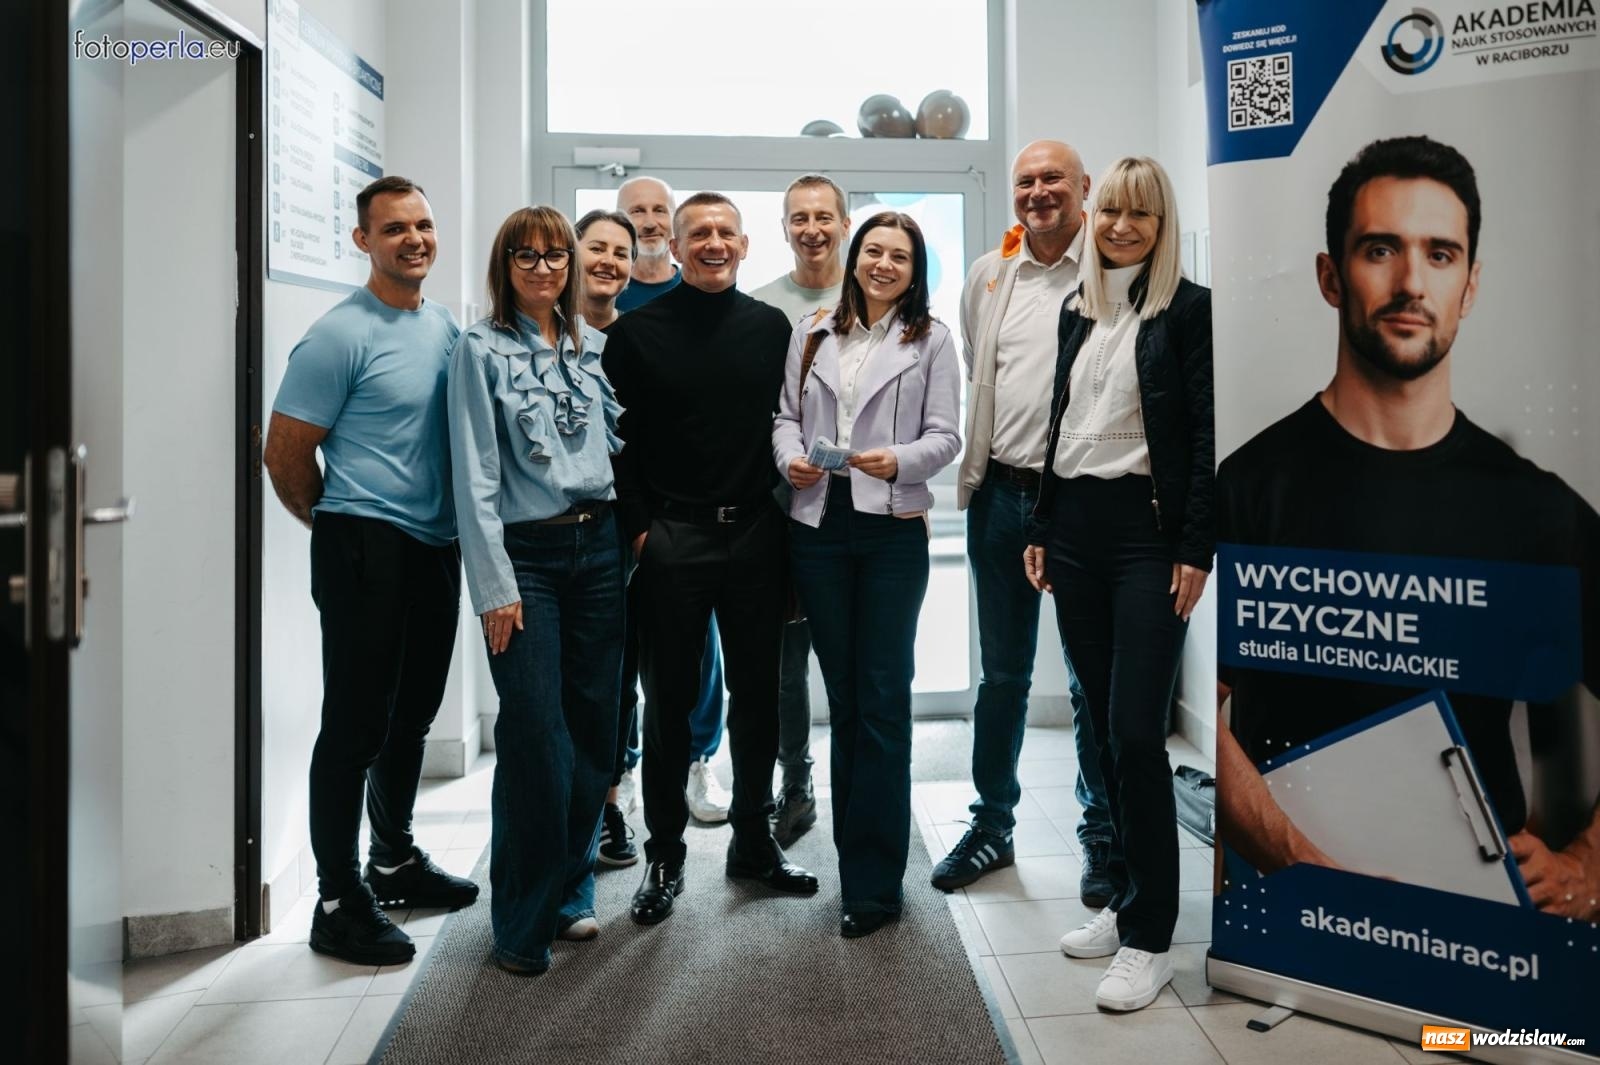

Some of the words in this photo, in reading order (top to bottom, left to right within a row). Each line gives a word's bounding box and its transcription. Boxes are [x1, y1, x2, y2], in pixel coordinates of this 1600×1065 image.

[1232, 27, 1270, 40] ZESKANUJ
[1271, 24, 1287, 34] KOD
[1452, 0, 1596, 35] AKADEMIA
[1452, 34, 1488, 49] NAUK
[1490, 20, 1597, 44] STOSOWANYCH
[1222, 41, 1254, 53] DOWIEDZ
[1255, 39, 1267, 48] SIĘ
[1476, 55, 1490, 66] W
[1492, 44, 1570, 64] RACIBORZU
[1234, 562, 1488, 607] WYCHOWANIE
[1236, 599, 1419, 644] FIZYCZNE
[1238, 640, 1298, 661] studia
[1303, 643, 1459, 680] LICENCJACKIE
[1300, 906, 1539, 981] akademiarac.pl
